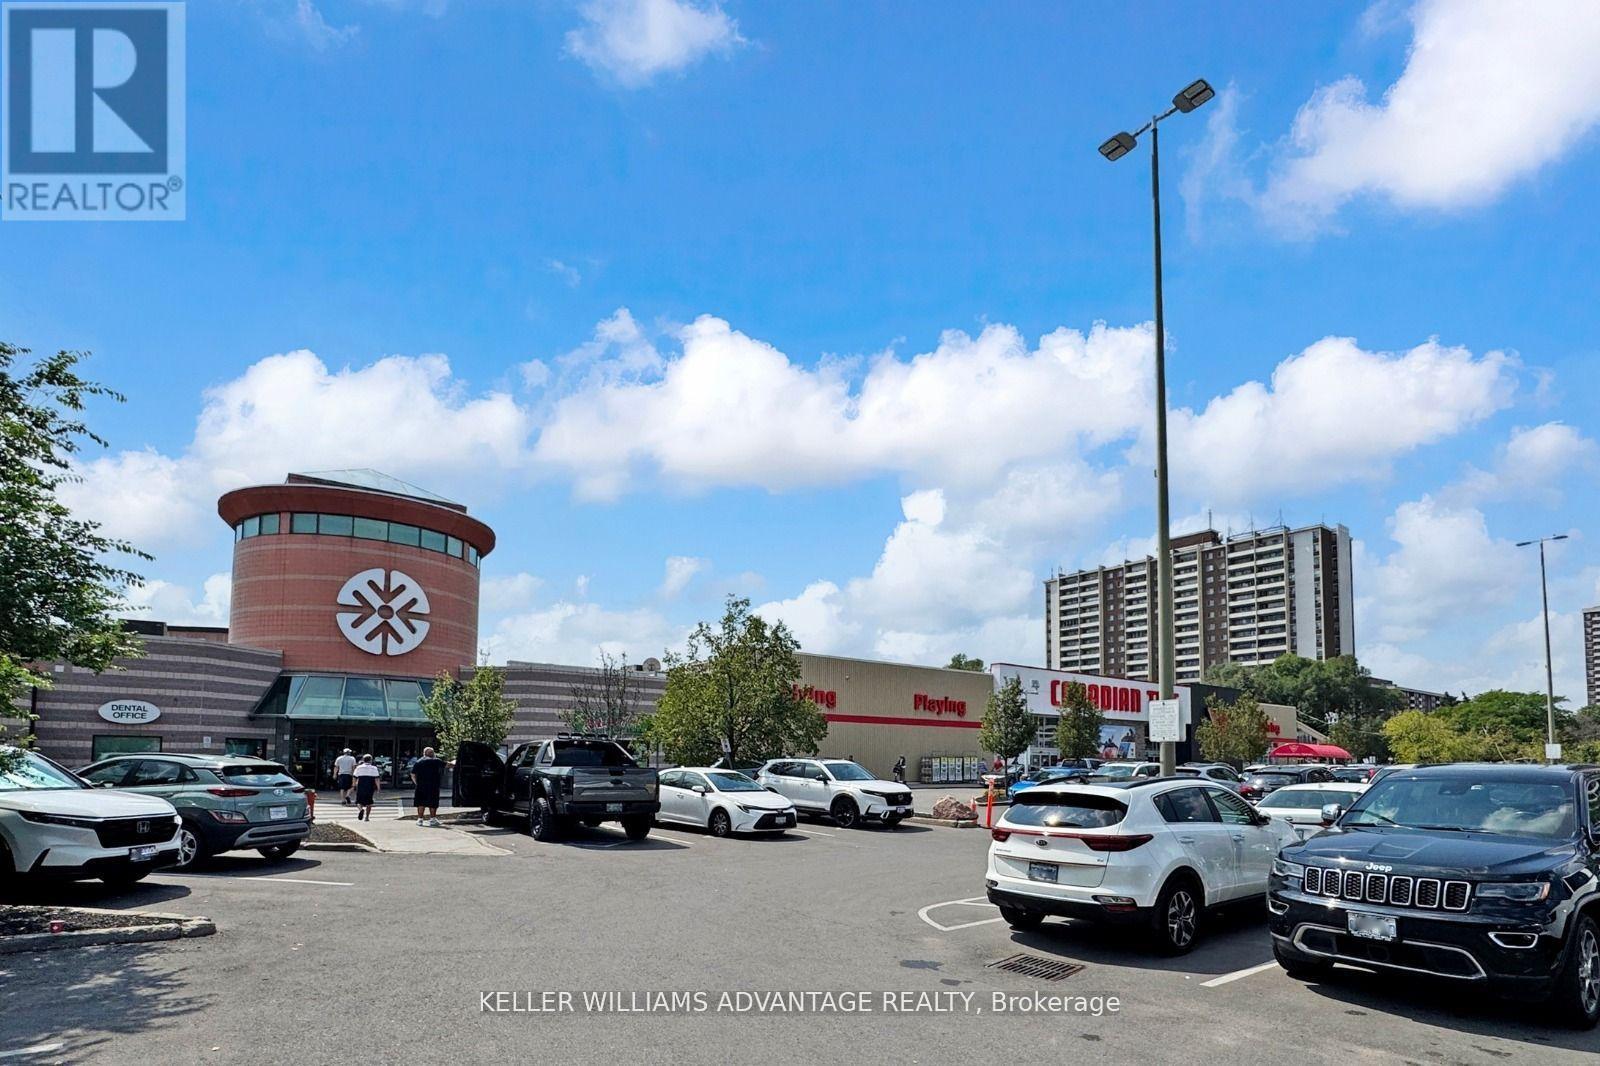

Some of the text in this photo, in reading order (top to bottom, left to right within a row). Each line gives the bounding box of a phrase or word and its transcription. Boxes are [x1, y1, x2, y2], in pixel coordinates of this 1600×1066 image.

[111, 704, 148, 712] DENTAL
[913, 694, 966, 718] Playing
[112, 711, 148, 719] OFFICE
[1365, 862, 1393, 872] Jeep
